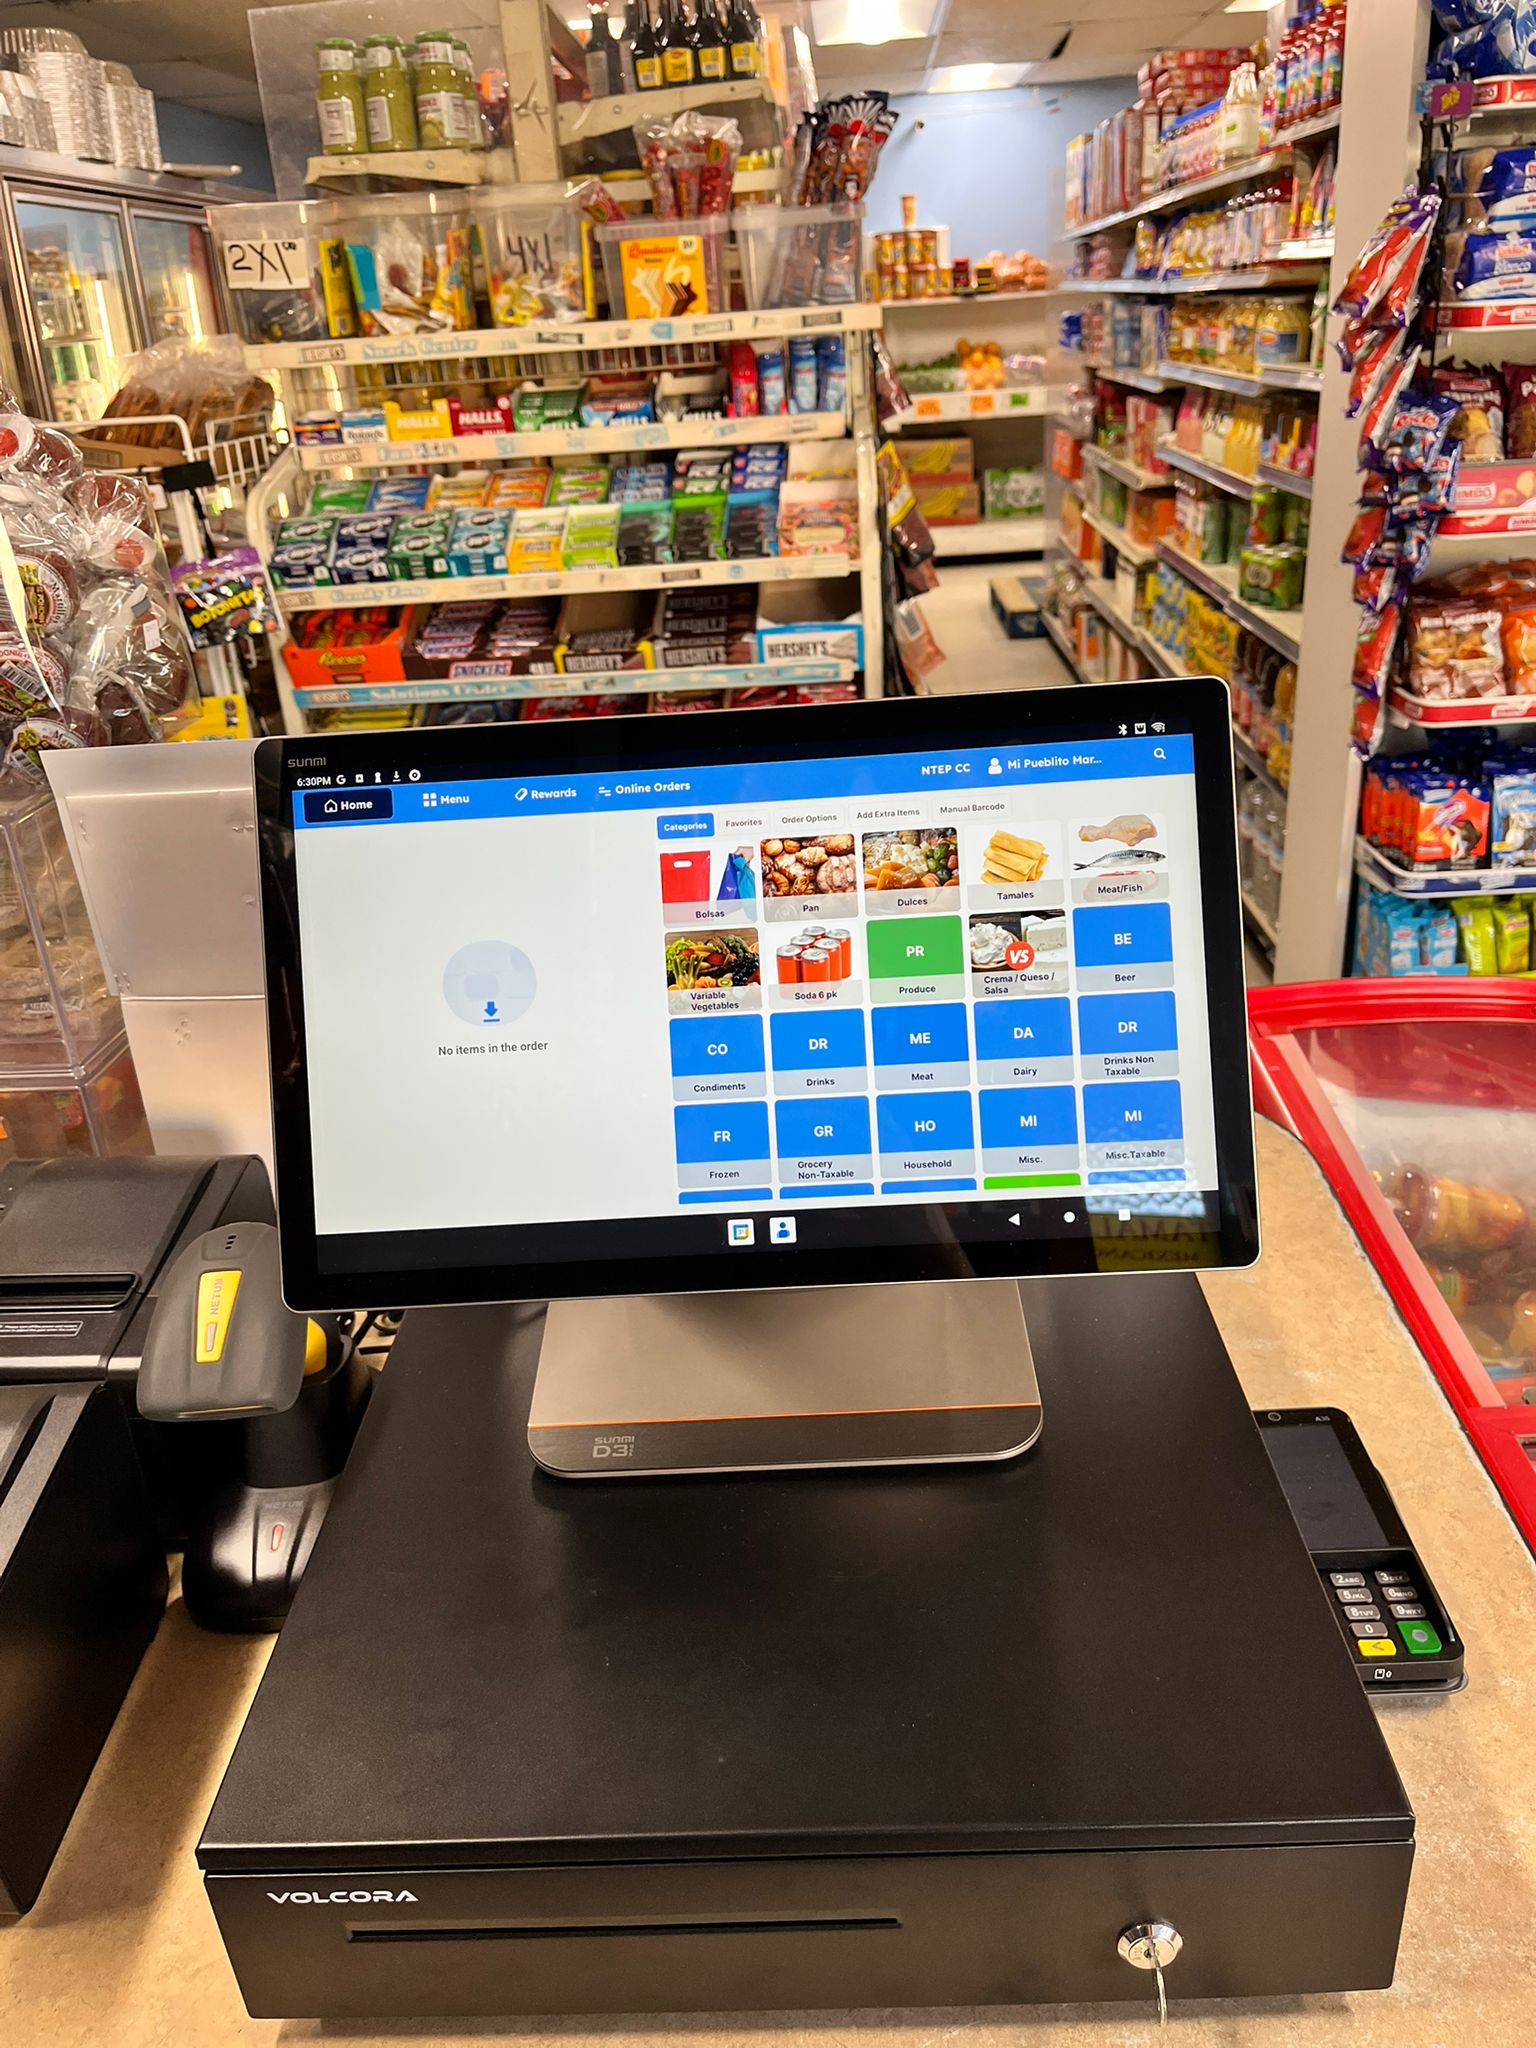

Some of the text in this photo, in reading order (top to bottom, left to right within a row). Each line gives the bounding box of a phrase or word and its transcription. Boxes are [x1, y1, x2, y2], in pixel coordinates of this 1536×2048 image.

[1494, 261, 1532, 274] Blanco
[396, 416, 441, 429] HALLS
[458, 410, 504, 426] HALLS
[767, 641, 829, 658] HERSHEY'S
[665, 646, 727, 666] HERSHEY'S
[565, 654, 624, 672] HERSHEY'S
[453, 663, 509, 678] SNICKERS
[288, 757, 326, 768] SUNMI
[1007, 759, 1021, 770] Mi
[1024, 756, 1070, 769] Pueblito
[921, 763, 971, 776] NTEP CC
[296, 776, 331, 787] 6:30PM
[615, 780, 691, 795] Online Orders
[440, 793, 470, 805] Menu
[531, 787, 577, 800] Rewards
[340, 800, 373, 811] Home
[940, 802, 1006, 815] Manual Barcode
[781, 813, 838, 825] Order Options
[857, 808, 920, 820] Add Extra Items
[664, 821, 708, 834] Categories
[725, 818, 763, 829] Favorites
[1097, 883, 1143, 895] Meat/Fish
[997, 890, 1034, 901] Tamales
[803, 903, 819, 913] Pan
[897, 897, 928, 907] Dulces
[695, 909, 725, 919] Bolsas
[1114, 932, 1132, 945] BE
[905, 945, 925, 957] PR
[1010, 949, 1029, 964] VS
[984, 974, 1013, 984] Crema
[1020, 972, 1048, 983] Queso
[1114, 973, 1135, 983] Beer
[690, 990, 726, 1001] Variable
[794, 990, 838, 1001] Soda 6 pk
[899, 984, 936, 995] Produce
[984, 985, 1009, 995] Salsa
[691, 1001, 739, 1013] Vegetables
[1013, 1027, 1034, 1039] DA
[1118, 1022, 1138, 1034] DR
[808, 1038, 828, 1050] DR
[909, 1033, 931, 1045] ME
[438, 1041, 549, 1056] No items in the order
[707, 1043, 728, 1056] CO
[1104, 1055, 1154, 1066] Drinks Non
[911, 1072, 934, 1082] Meat
[1013, 1066, 1038, 1078] Dairy
[1105, 1066, 1140, 1077] Taxable
[693, 1082, 747, 1093] Condiments
[806, 1077, 835, 1087] Drinks
[1020, 1115, 1037, 1127] MI
[1124, 1110, 1142, 1122] MI
[814, 1125, 833, 1137] GR
[914, 1120, 936, 1132] HO
[713, 1131, 731, 1143] FR
[797, 1159, 833, 1171] Grocery
[903, 1159, 952, 1170] Household
[1018, 1155, 1043, 1165] Misc.
[709, 1169, 740, 1180] Frozen
[798, 1169, 854, 1180] Non-Taxable
[209, 1278, 224, 1317] NETUM
[594, 1435, 635, 1445] SUNMI
[592, 1444, 628, 1458] D3
[1364, 1624, 1374, 1634] 0
[266, 1889, 419, 1904] VOLCORA
